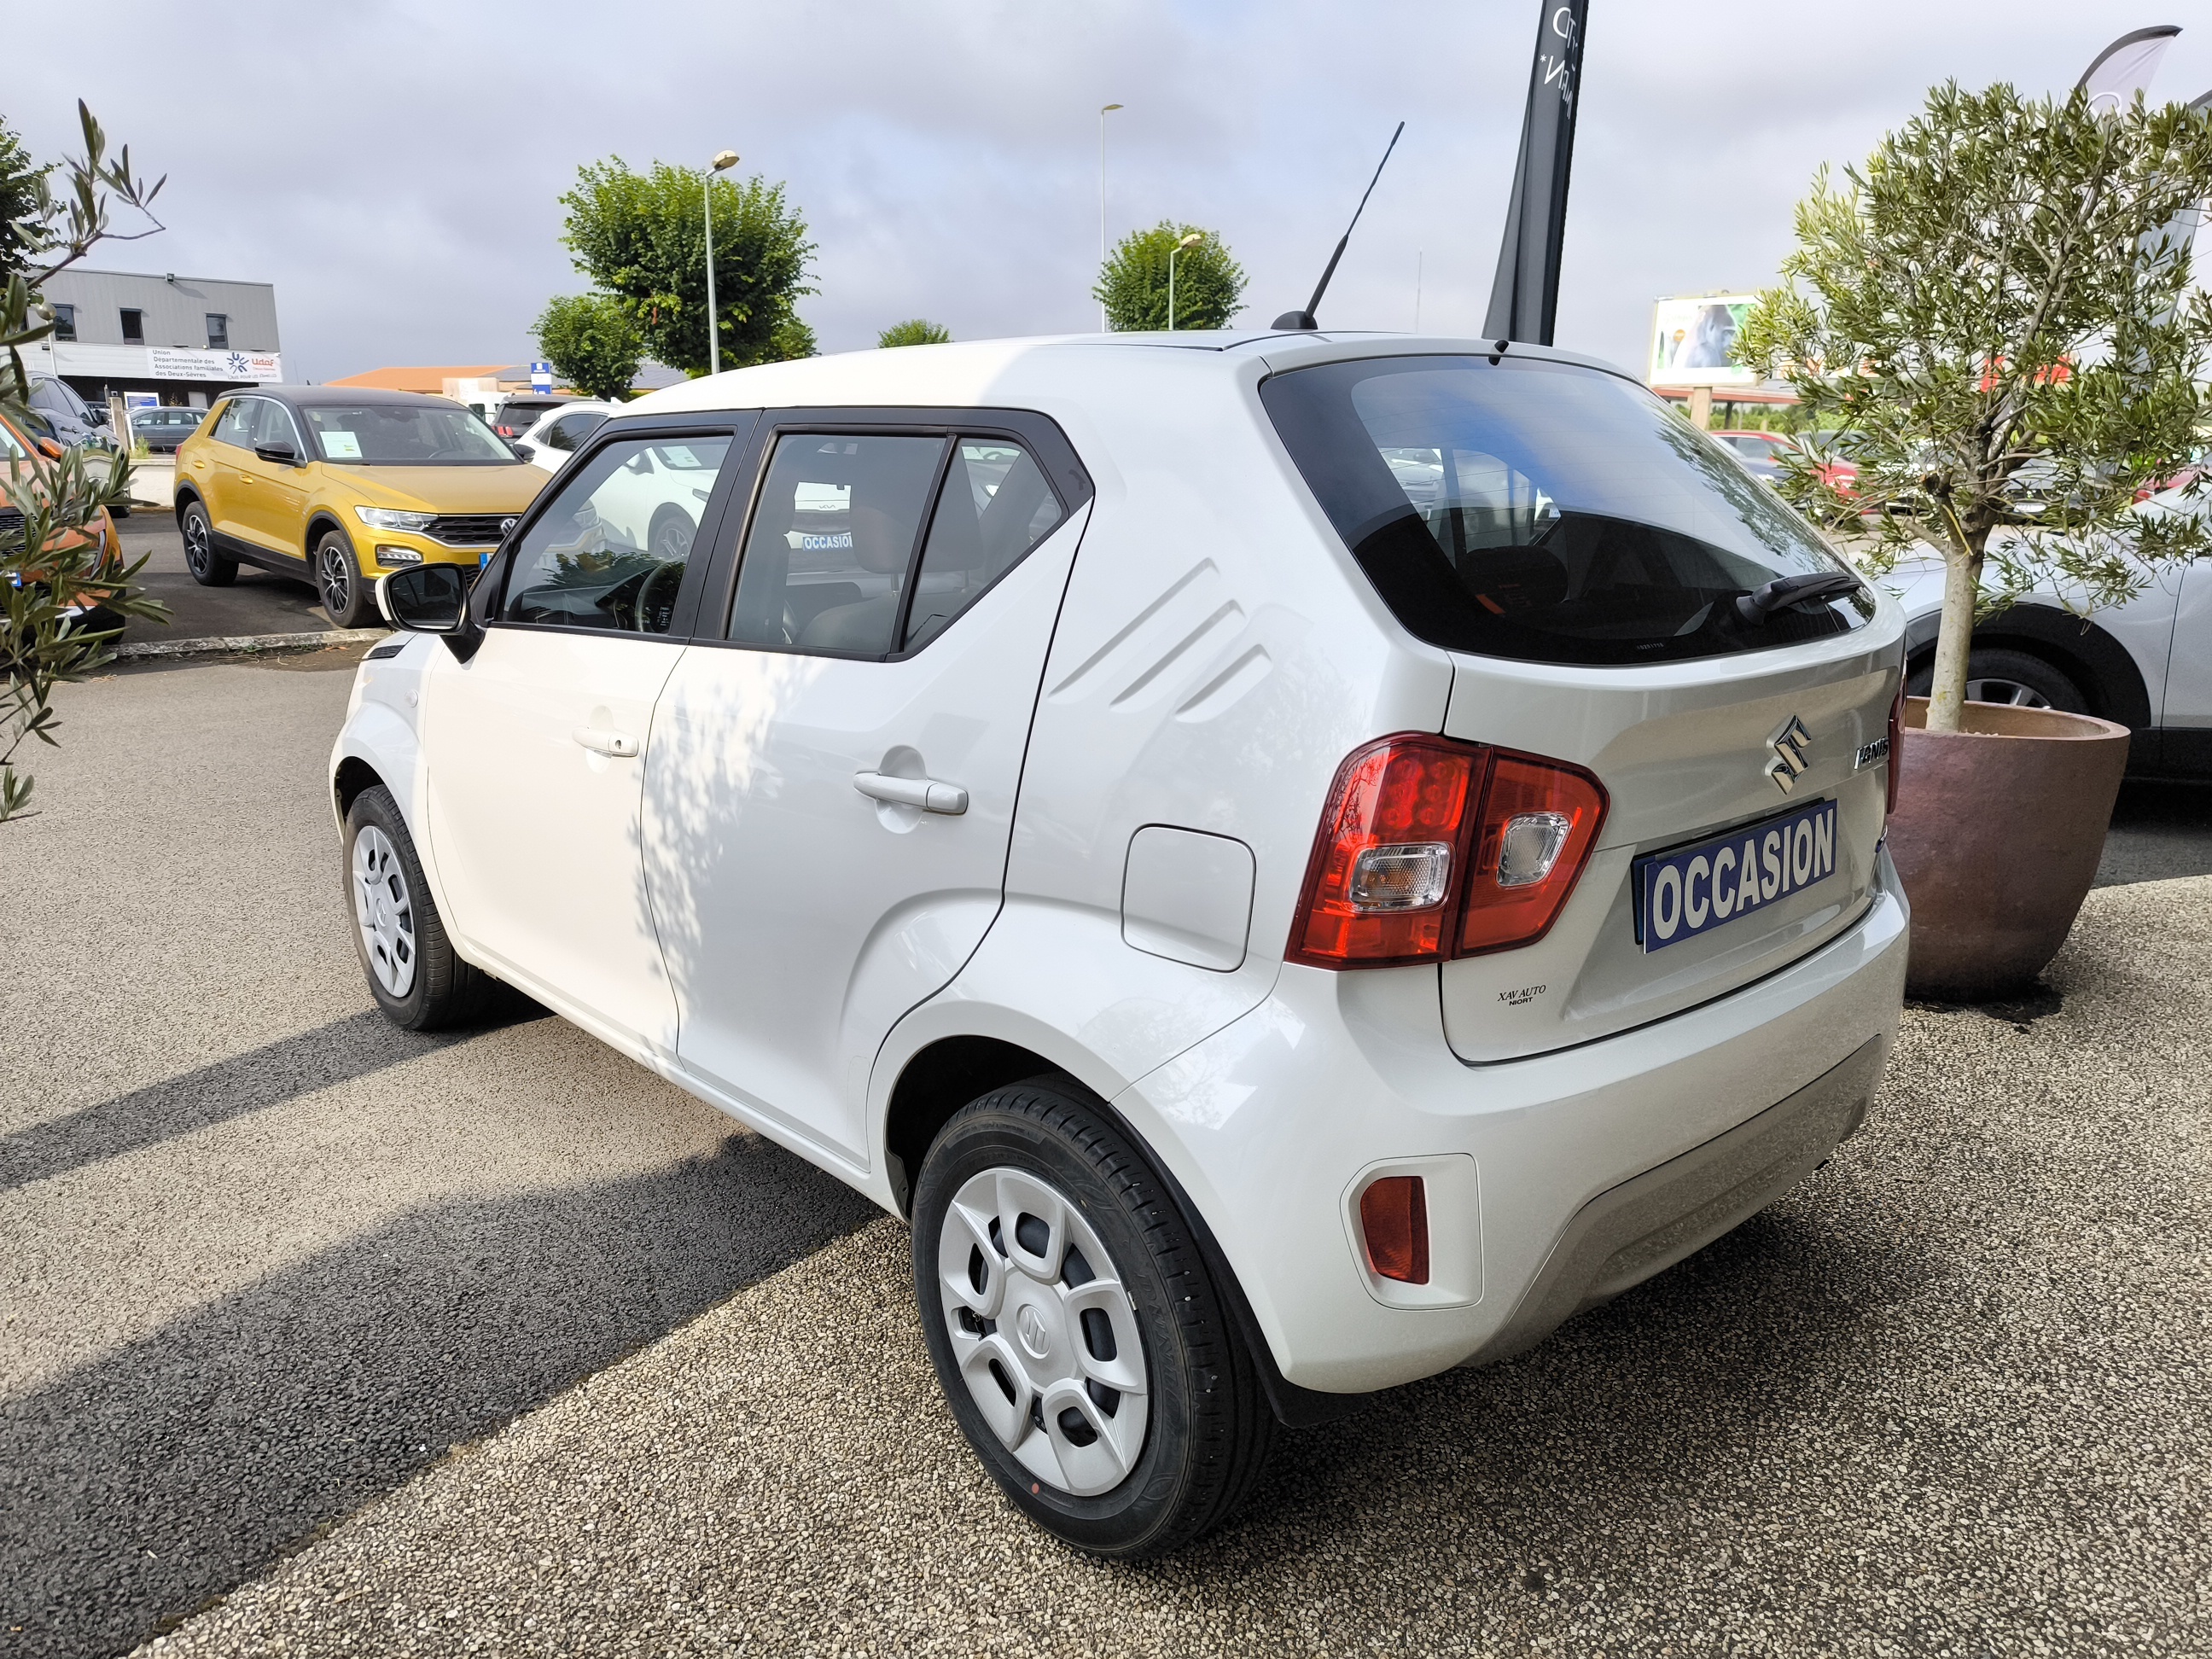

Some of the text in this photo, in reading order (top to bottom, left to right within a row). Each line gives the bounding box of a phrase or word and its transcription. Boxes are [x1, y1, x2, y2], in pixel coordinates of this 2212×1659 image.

[1652, 808, 1833, 940] OCCASION
[1497, 984, 1546, 1002] XAV AUTO
[1509, 997, 1534, 1006] NIORT
